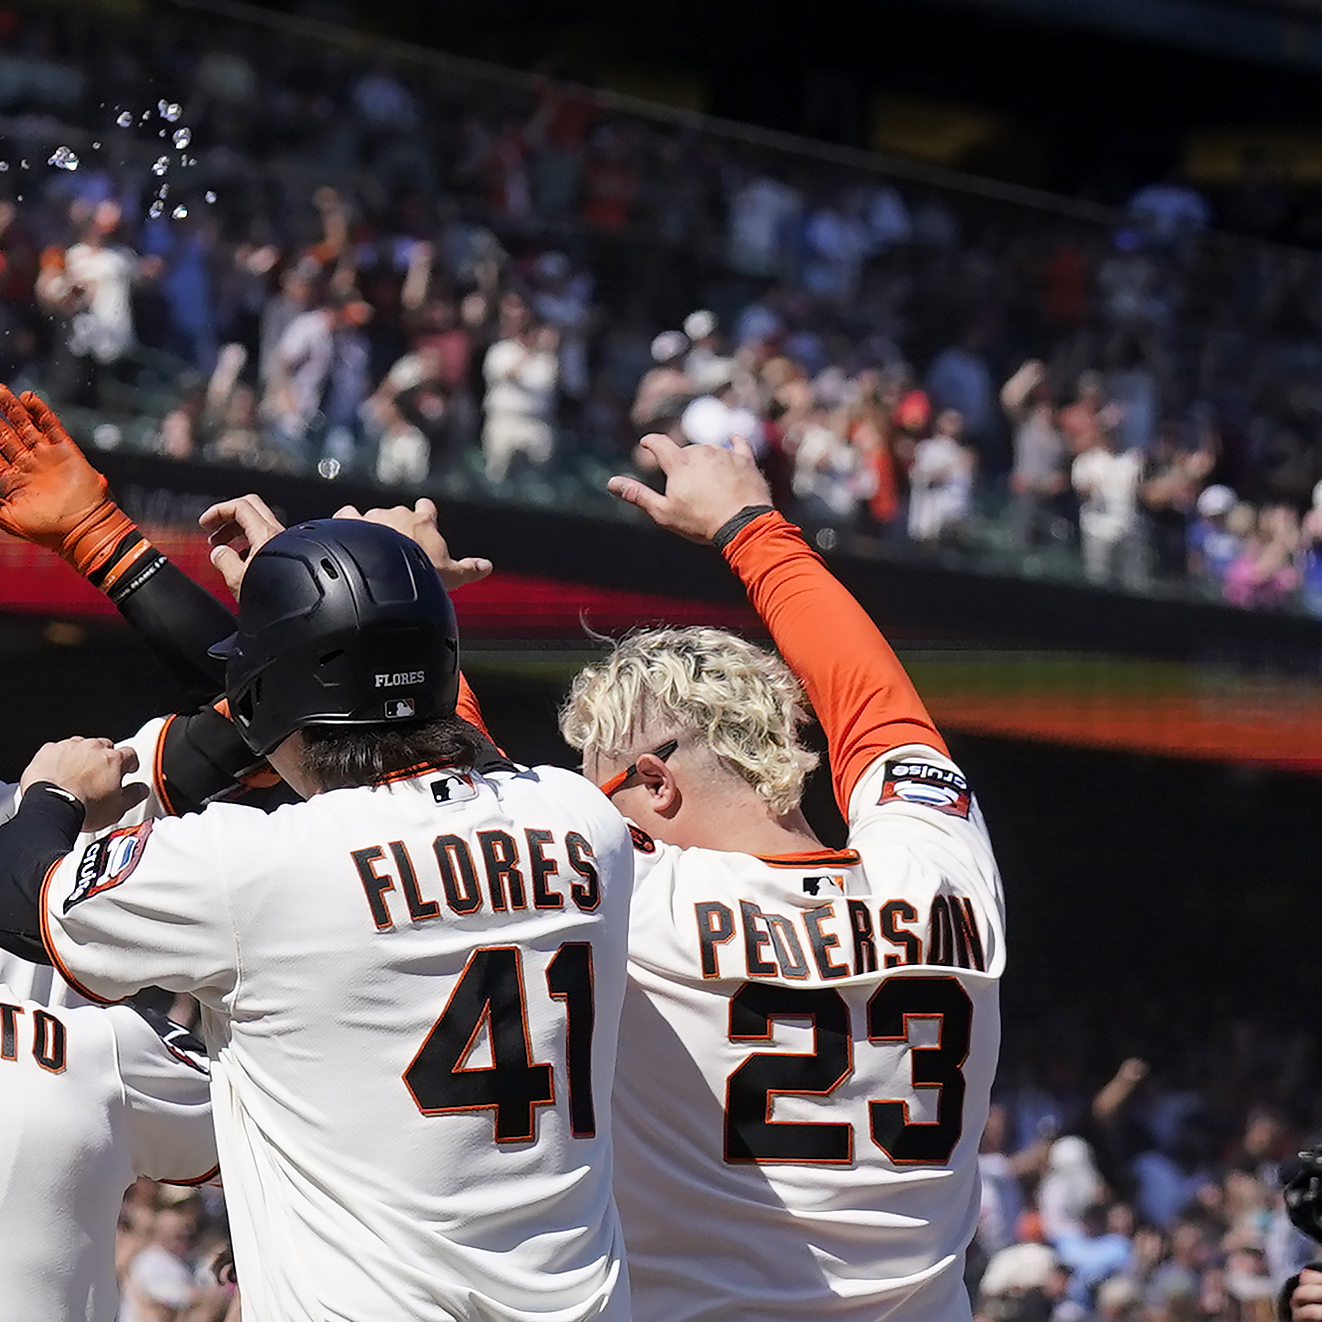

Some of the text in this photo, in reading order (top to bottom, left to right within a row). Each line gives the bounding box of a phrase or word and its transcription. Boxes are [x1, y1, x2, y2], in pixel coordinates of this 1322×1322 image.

[374, 670, 425, 687] FLORES
[891, 765, 968, 790] cruise
[349, 828, 602, 932] FLORES
[694, 895, 988, 981] PEDERSON
[402, 941, 596, 1144] 41
[722, 975, 974, 1166] 23
